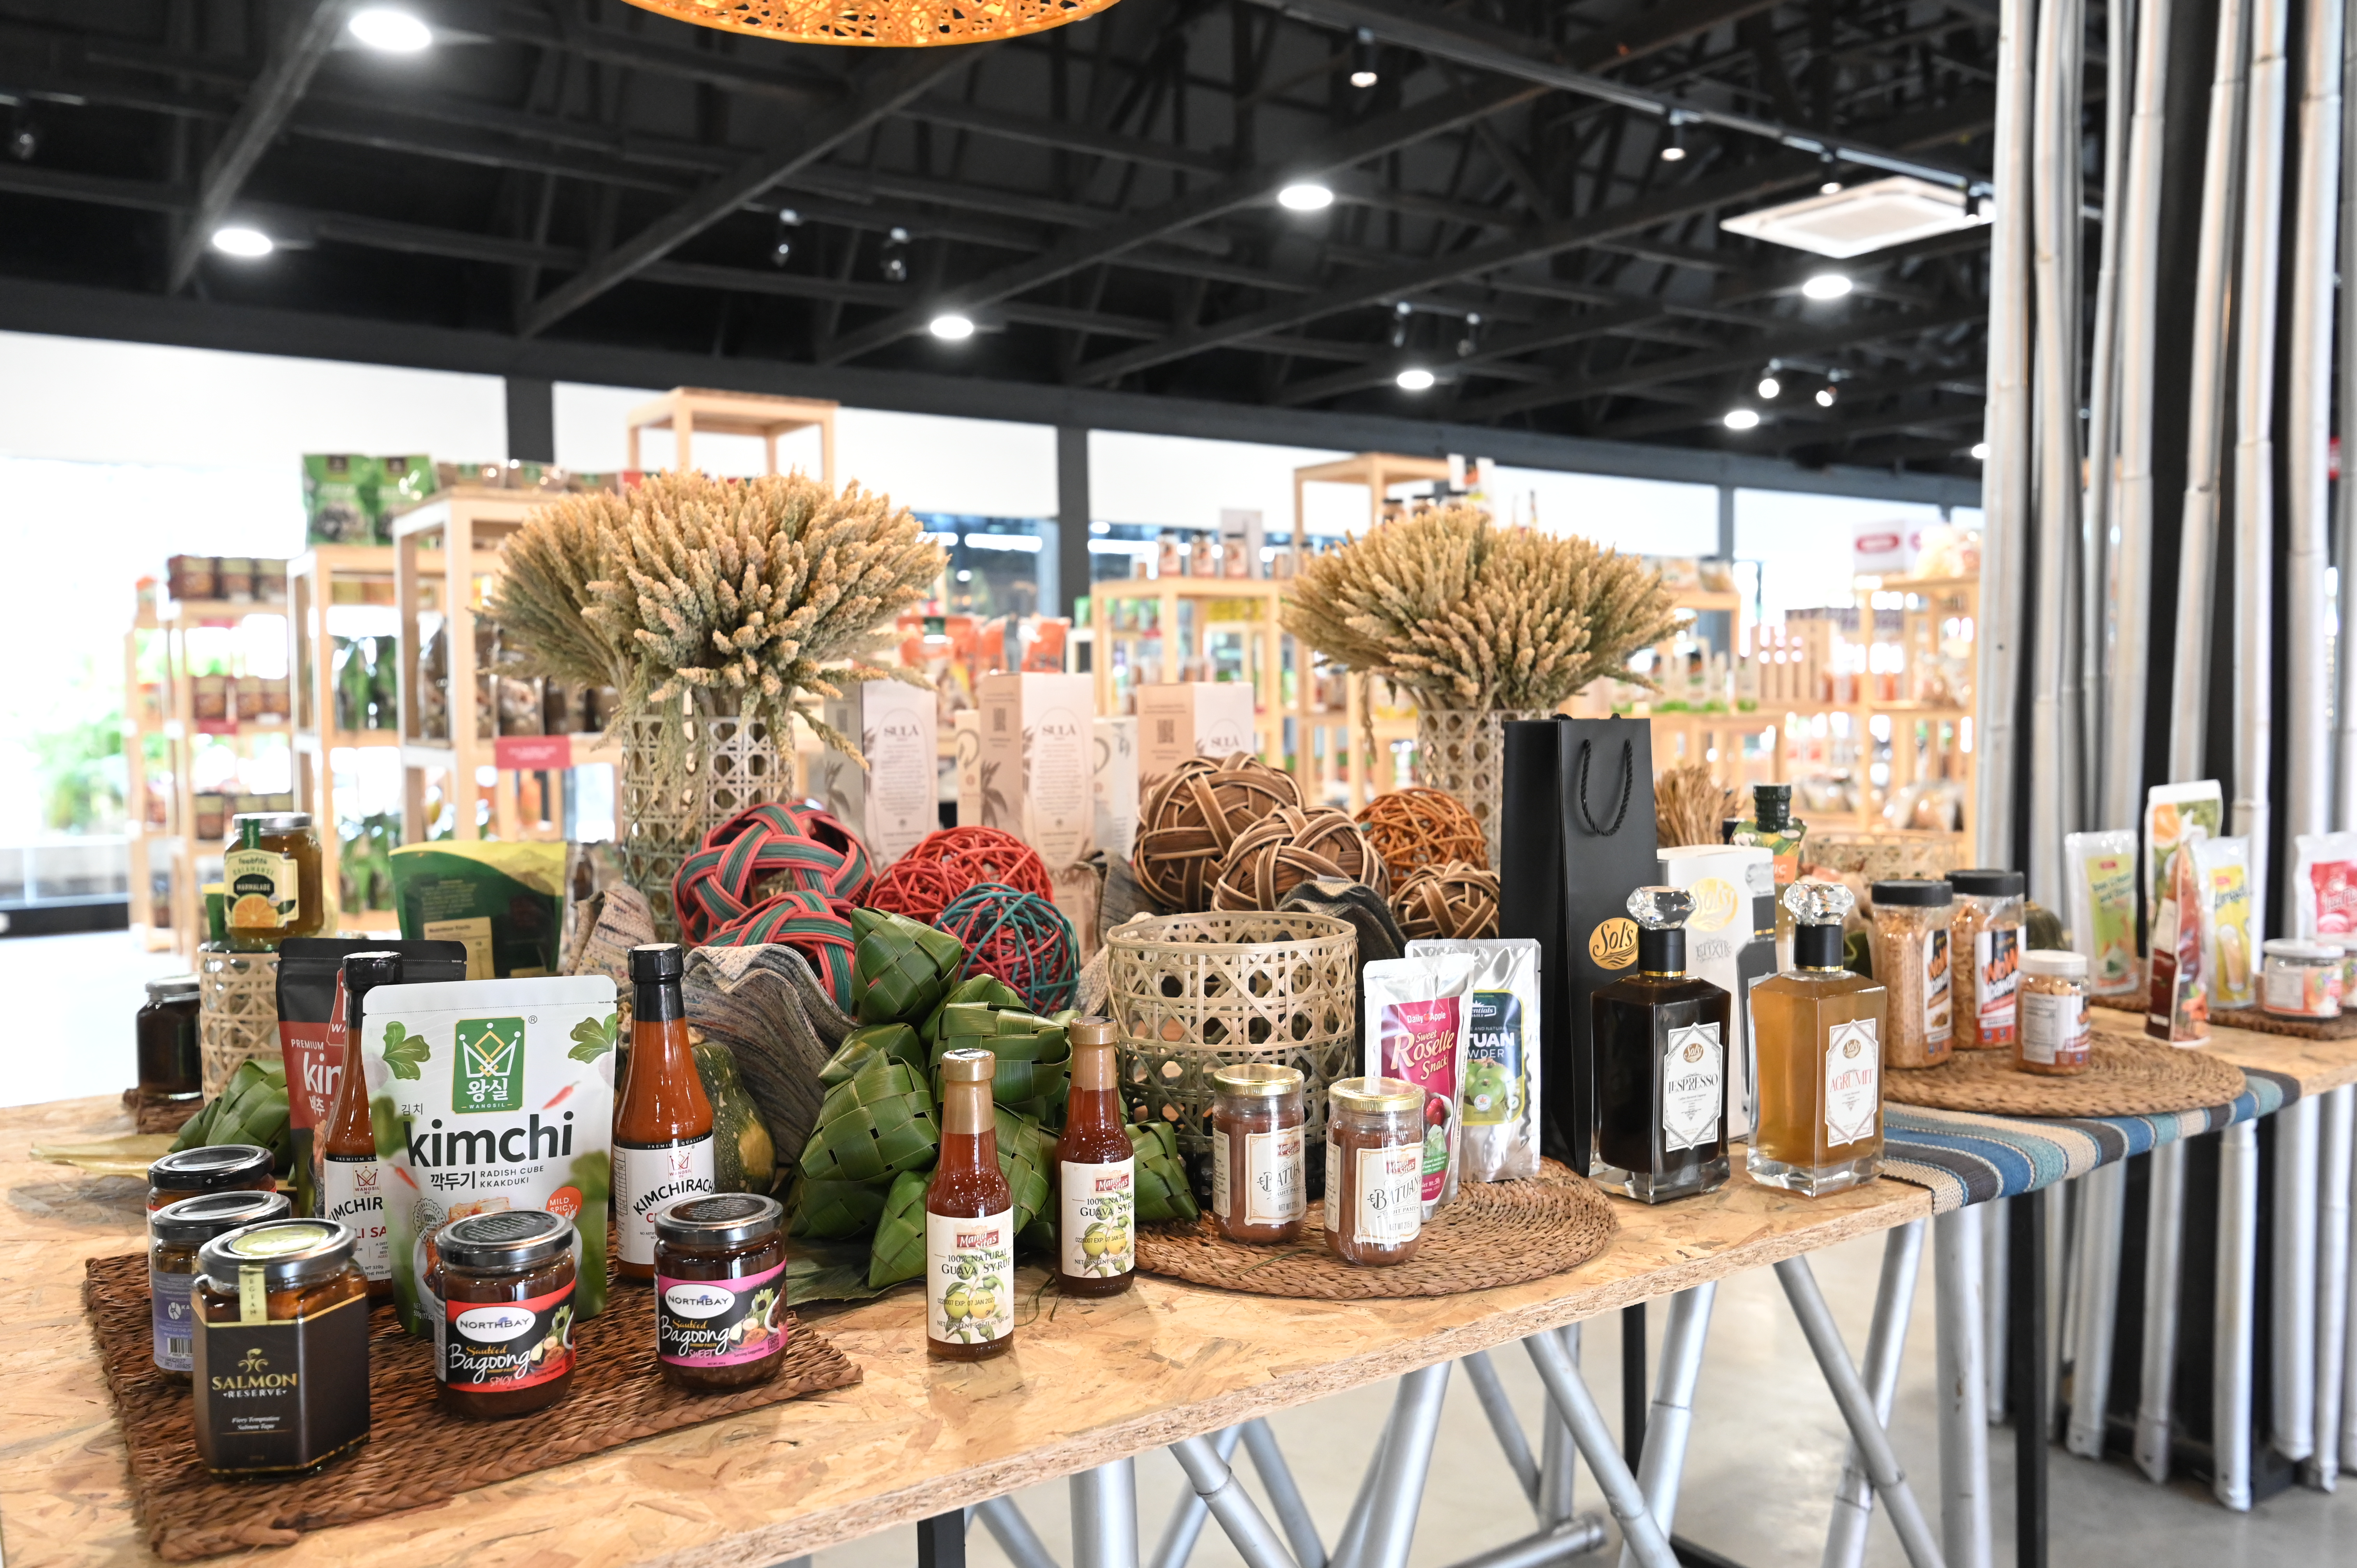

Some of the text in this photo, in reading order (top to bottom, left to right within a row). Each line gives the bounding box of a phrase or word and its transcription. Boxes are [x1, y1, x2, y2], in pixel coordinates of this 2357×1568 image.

[1407, 1012, 1446, 1024] Daily Apple
[1416, 1029, 1437, 1043] Sweet
[291, 1039, 324, 1050] PREMIUM
[1391, 1029, 1454, 1070] Roselle
[1421, 1054, 1447, 1080] Snack
[466, 1078, 509, 1102] 왕실
[309, 1096, 325, 1117] 배추
[401, 1103, 423, 1116] 김치
[403, 1111, 574, 1167] kimchi
[682, 1136, 704, 1146] QUALITY
[481, 1165, 544, 1178] RADISH CUBE
[431, 1171, 475, 1191] 깍두기
[480, 1177, 529, 1188] KKAKDUKI
[1098, 1176, 1121, 1191] Mama
[1110, 1178, 1128, 1194] Sita's
[549, 1197, 569, 1206] MILD
[550, 1204, 574, 1213] SPICY
[328, 1196, 383, 1222] IMCHIR
[1080, 1207, 1114, 1217] GUAVA
[960, 1232, 987, 1247] Mama
[974, 1234, 997, 1251] Sita's
[971, 1248, 1007, 1262] NATURAL
[942, 1264, 977, 1275] GUAVA
[984, 1257, 1011, 1273] SYRUP
[668, 1294, 730, 1306] NORTHBAY
[413, 1310, 422, 1319] 500g
[460, 1317, 530, 1329] NORTHBAY
[660, 1315, 731, 1356] Bagoong
[689, 1349, 716, 1359] SWEET
[449, 1343, 532, 1384] Bagoong
[212, 1373, 297, 1390] SALMON
[489, 1376, 513, 1387] SPICY
[228, 1388, 283, 1398] RESERVE
